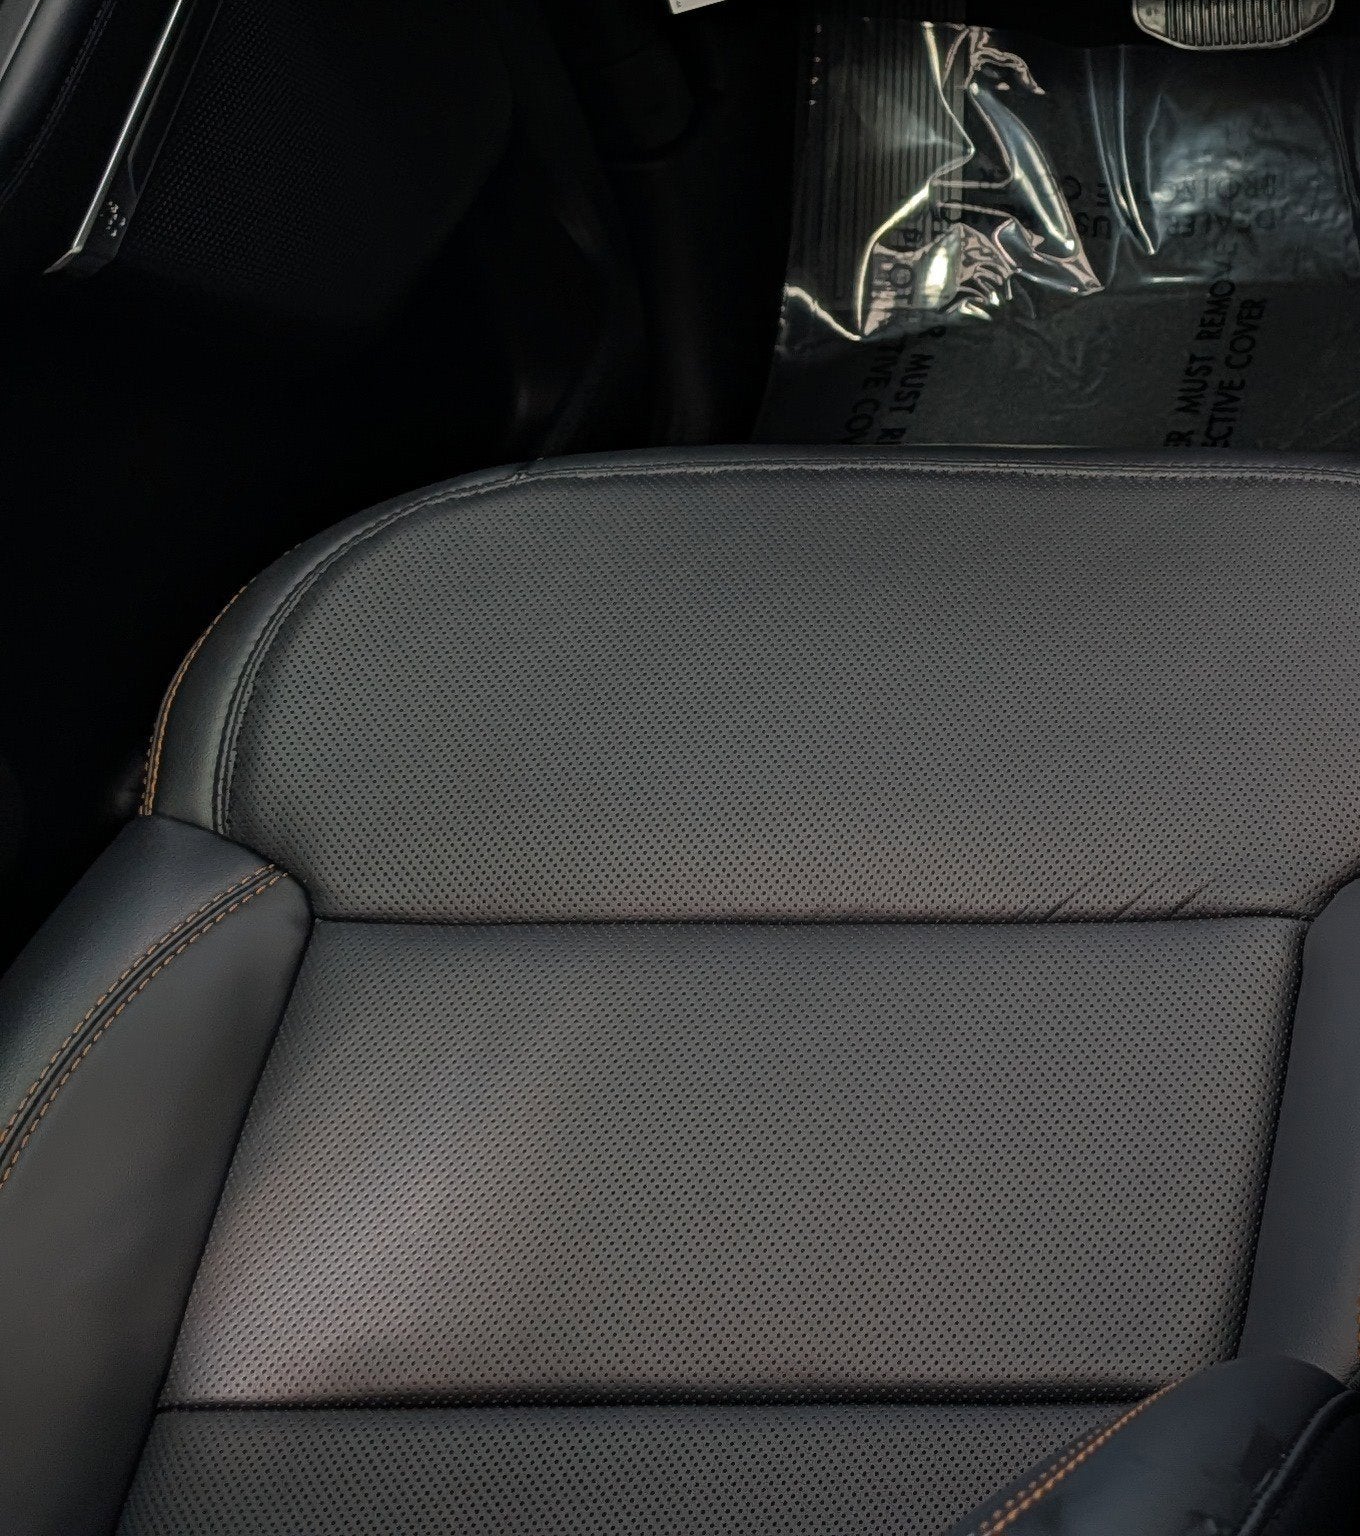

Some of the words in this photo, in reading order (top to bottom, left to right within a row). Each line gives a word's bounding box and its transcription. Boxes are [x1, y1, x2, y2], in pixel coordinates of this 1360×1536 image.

[1224, 297, 1268, 371] COVER
[889, 353, 935, 415] MUST
[1174, 354, 1215, 414] MUST
